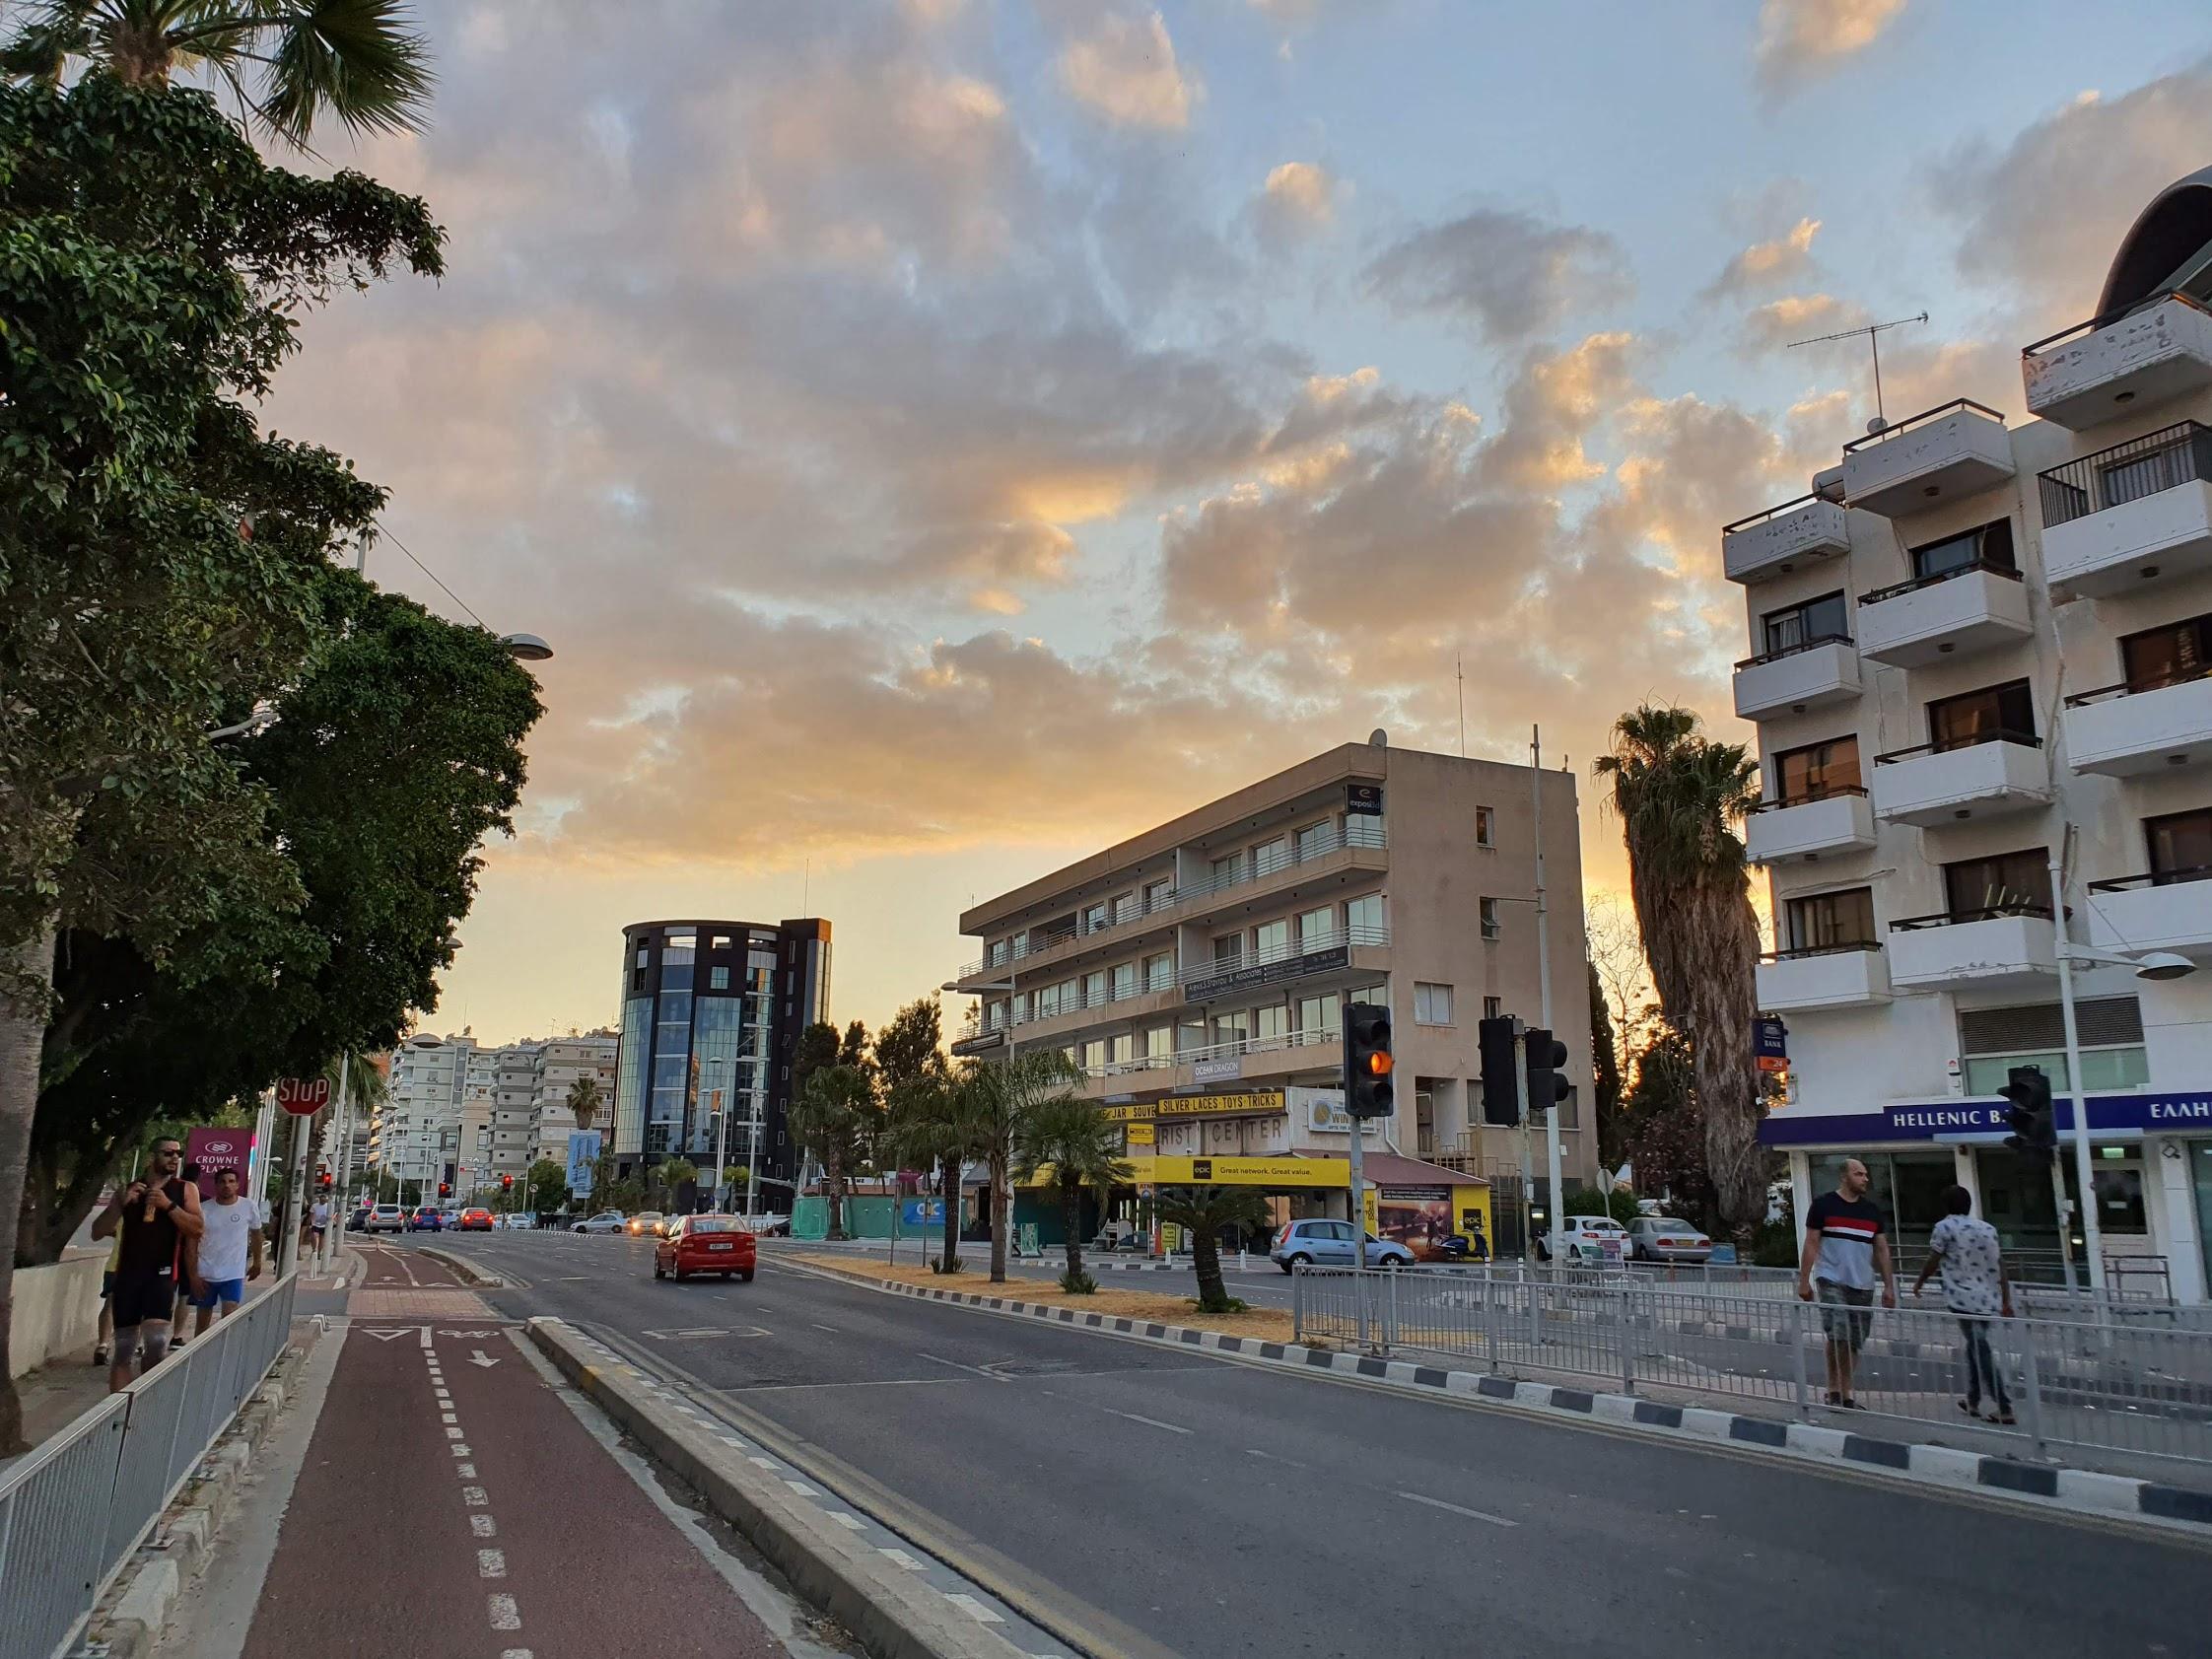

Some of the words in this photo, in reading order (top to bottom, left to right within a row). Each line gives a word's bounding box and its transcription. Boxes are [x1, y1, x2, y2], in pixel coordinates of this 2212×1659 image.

[1195, 1065, 1213, 1075] OCEAN
[1213, 1062, 1238, 1073] DRAGON
[278, 1077, 327, 1103] STOP
[1163, 1099, 1190, 1113] SILVER
[1193, 1097, 1218, 1111] LACES
[1221, 1095, 1243, 1109] TOYS
[1248, 1093, 1277, 1107] TRICKS
[2150, 1101, 2212, 1119] ΕΛΛΗ
[1112, 1108, 1127, 1119] JAR
[1893, 1111, 1981, 1127] HELLENIC
[1159, 1125, 1192, 1146] RIST
[1212, 1118, 1281, 1143] CENTER
[195, 1155, 240, 1165] CROWNE
[1219, 1166, 1239, 1175] Great
[1272, 1167, 1290, 1176] Great
[1464, 1215, 1481, 1225] epic
